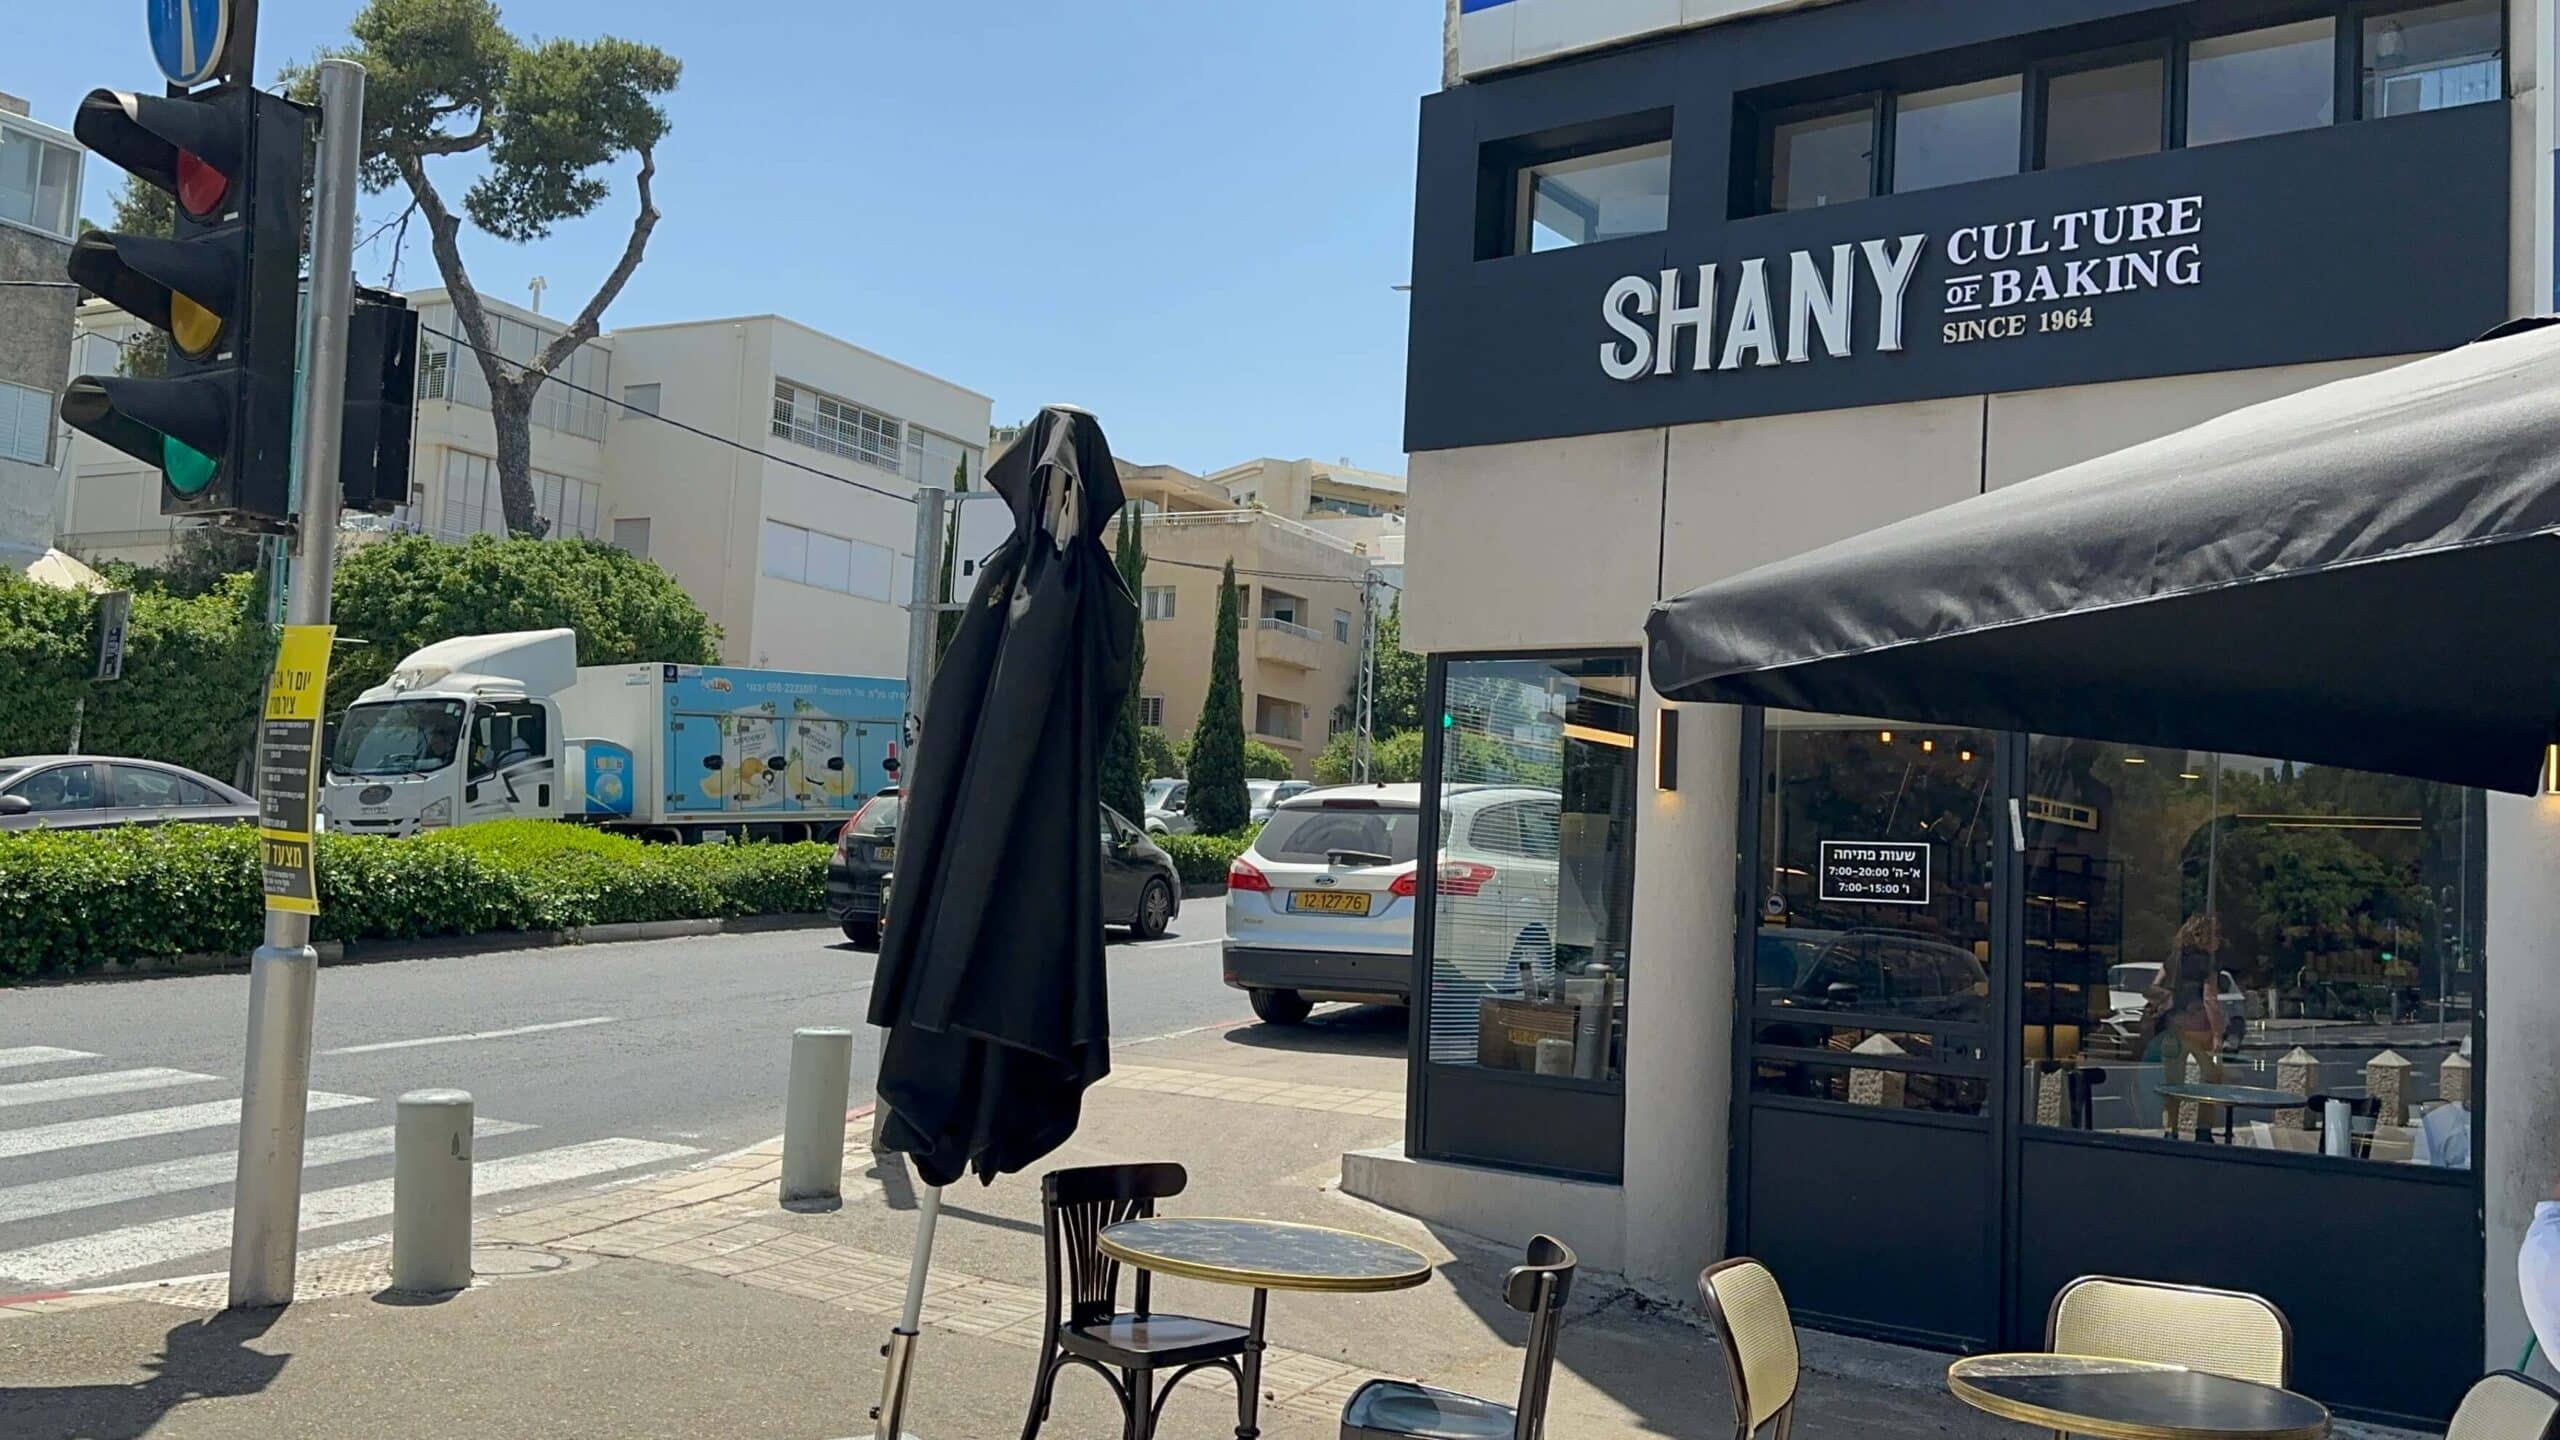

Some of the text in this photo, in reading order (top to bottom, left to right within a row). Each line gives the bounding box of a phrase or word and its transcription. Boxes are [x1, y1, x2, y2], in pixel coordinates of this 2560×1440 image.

[1946, 194, 2204, 265] CULTURE
[1947, 242, 2202, 309] OF BAKING
[1600, 232, 1926, 382] SHANY
[1942, 306, 2093, 344] SINCE 1964
[271, 844, 302, 868] מצעד
[1833, 848, 1916, 861] שעות פתיחה
[1828, 866, 1889, 877] 7:00-20:00
[1838, 882, 1899, 894] 7:00-15:00
